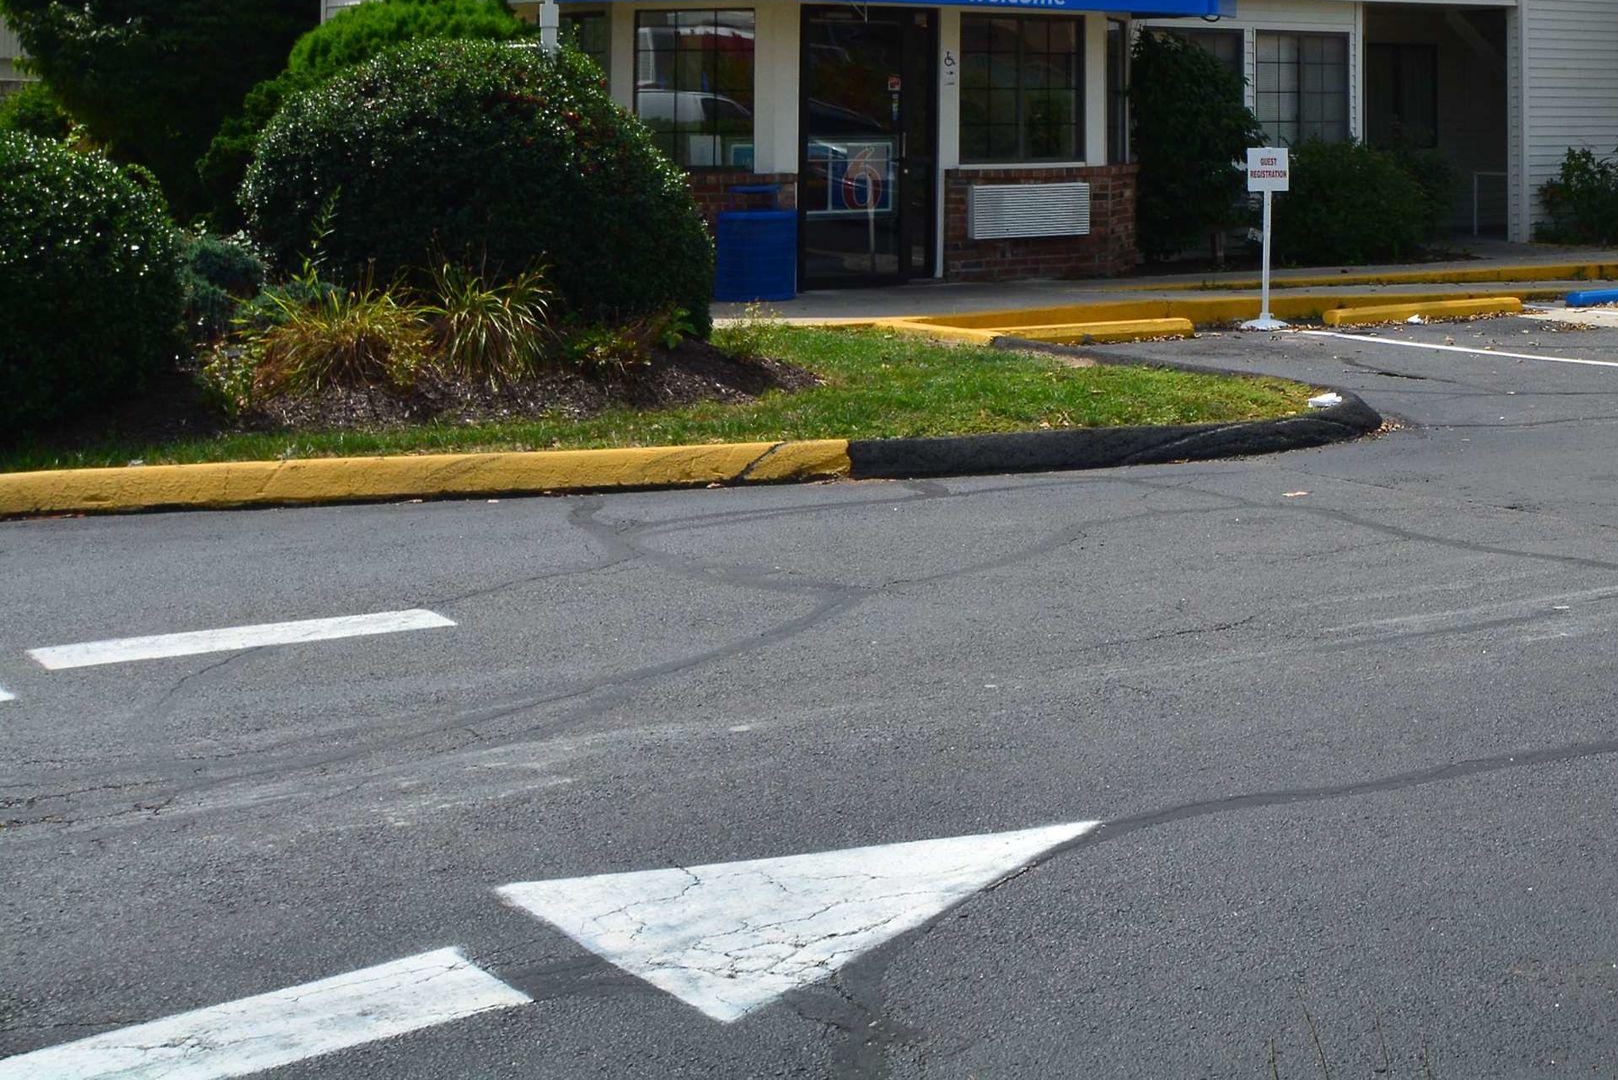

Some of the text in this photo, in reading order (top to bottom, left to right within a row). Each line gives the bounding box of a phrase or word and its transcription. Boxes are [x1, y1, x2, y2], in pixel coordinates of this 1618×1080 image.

[1260, 158, 1277, 166] GUEST
[841, 145, 883, 210] 6
[1249, 170, 1288, 179] REGISTRATION
